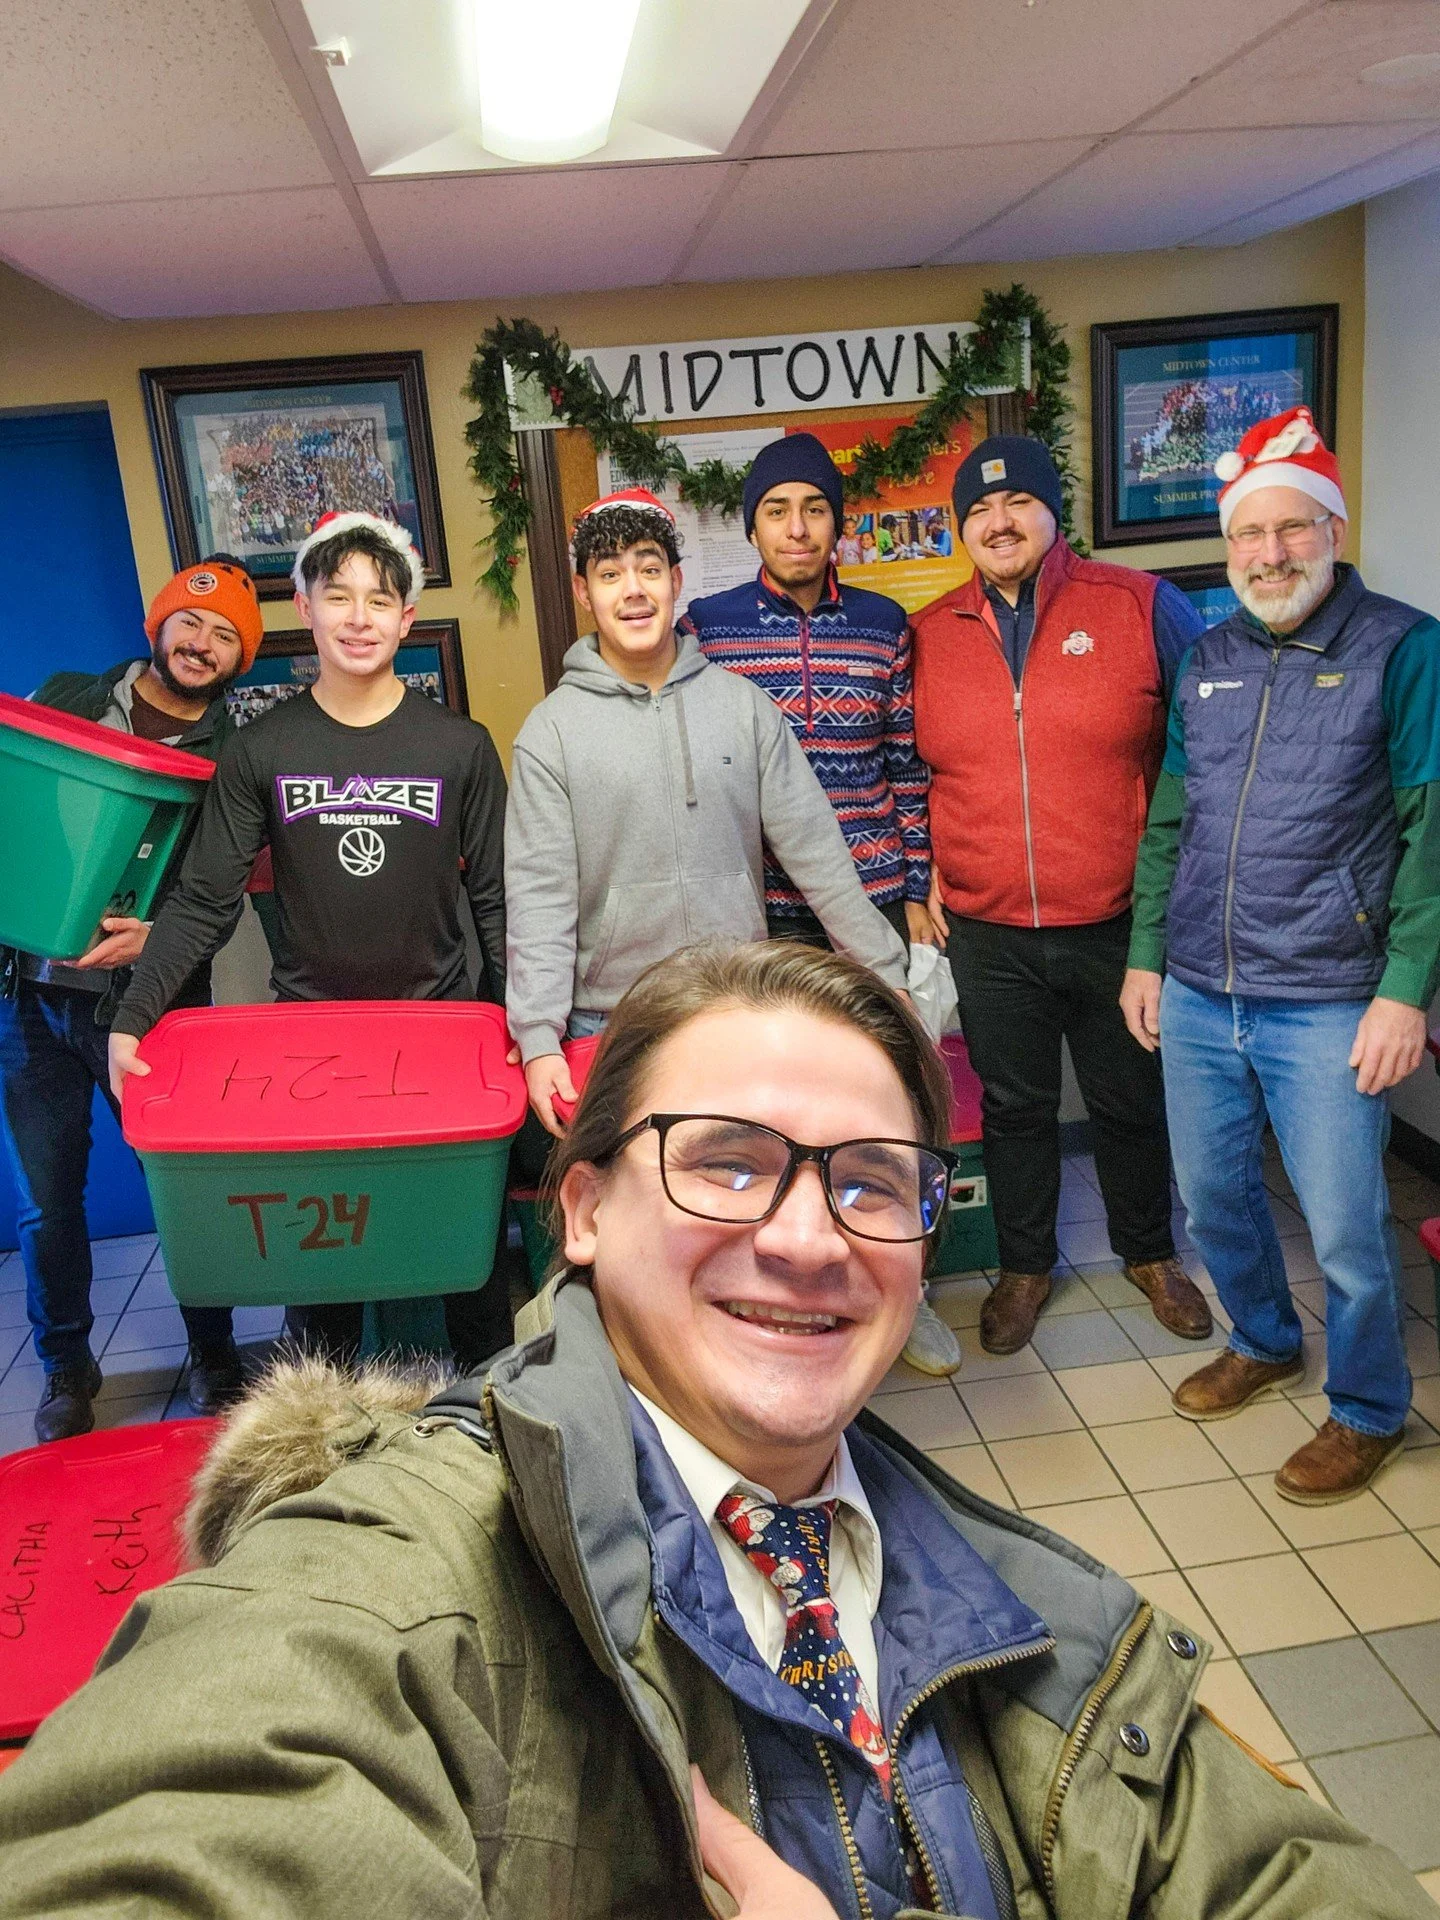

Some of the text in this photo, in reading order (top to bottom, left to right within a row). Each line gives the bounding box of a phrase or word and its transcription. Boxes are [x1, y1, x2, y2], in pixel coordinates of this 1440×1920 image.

[1162, 355, 1260, 373] MIDTOWN CENTER
[583, 331, 958, 416] MIDTOWN
[1153, 490, 1198, 504] SUMMER
[290, 666, 320, 677] MIDTO
[277, 775, 441, 824] BLAZE
[319, 813, 402, 826] BASKETBALL
[227, 1192, 371, 1261] T-24
